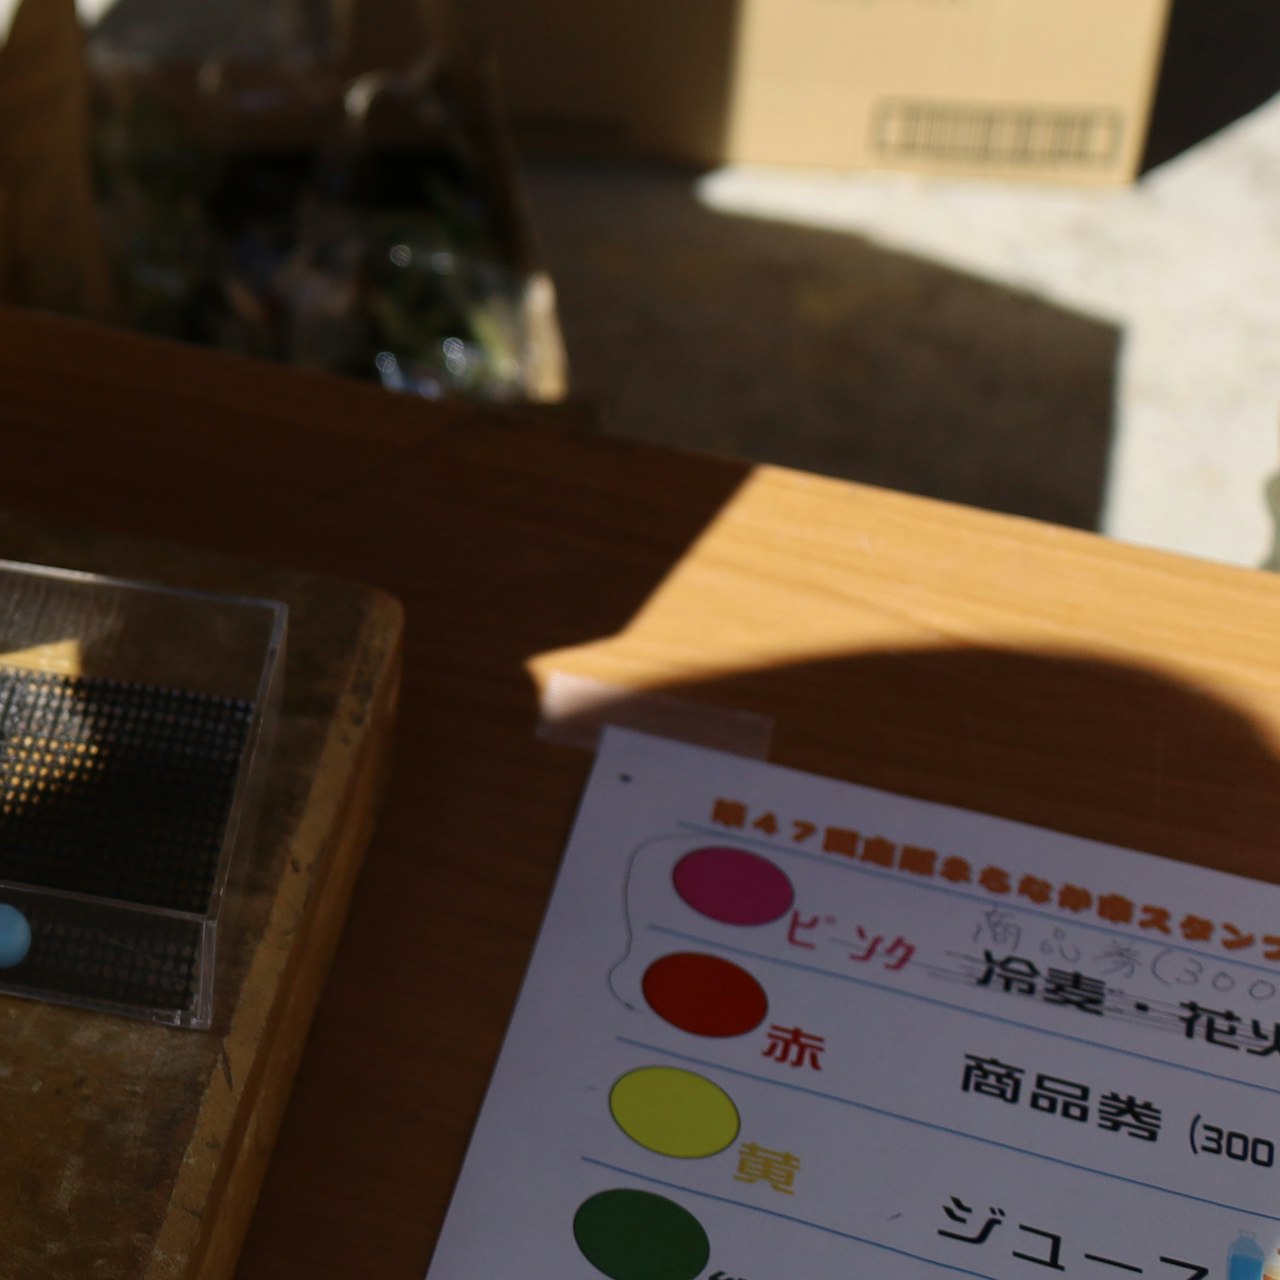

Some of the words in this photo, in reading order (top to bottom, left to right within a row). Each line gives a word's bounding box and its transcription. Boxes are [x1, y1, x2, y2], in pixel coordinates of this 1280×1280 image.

[787, 910, 916, 972] ピンク
[762, 1024, 825, 1070] 赤
[961, 1053, 1162, 1142] 商品券
[733, 1142, 801, 1195] 黄
